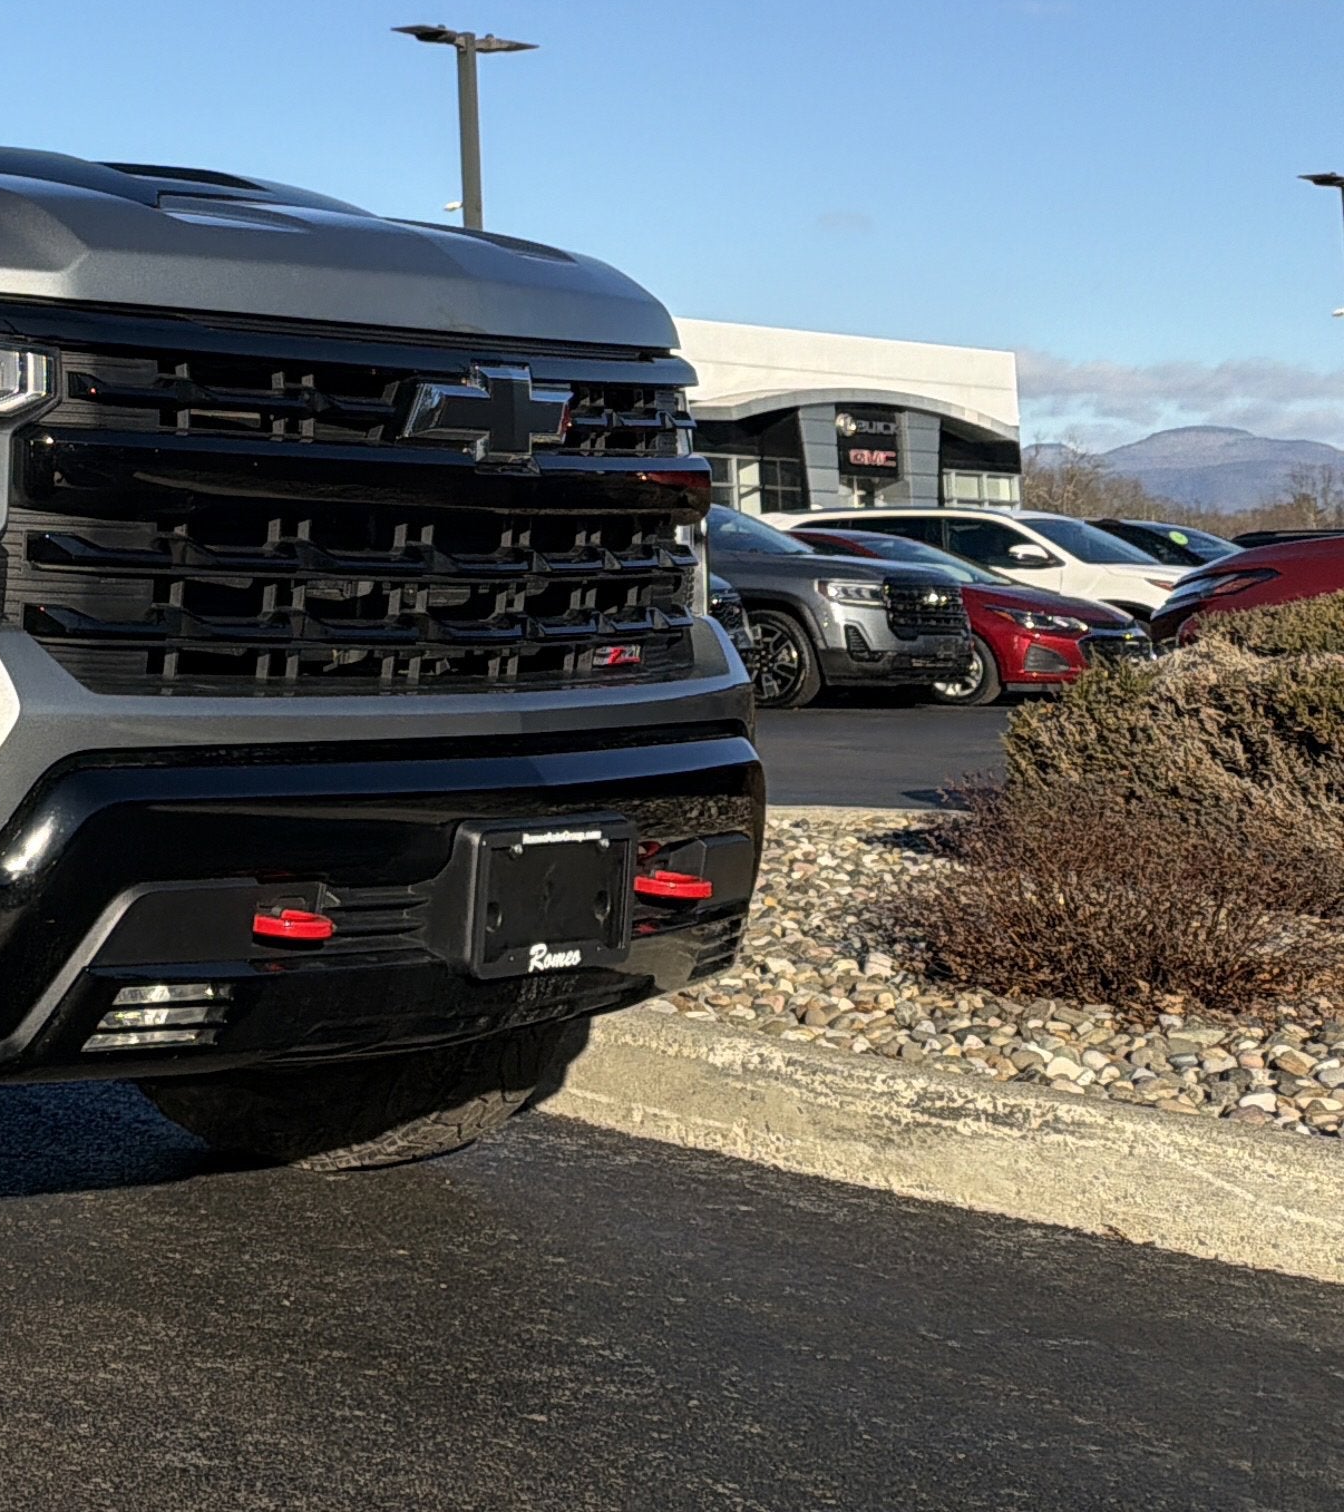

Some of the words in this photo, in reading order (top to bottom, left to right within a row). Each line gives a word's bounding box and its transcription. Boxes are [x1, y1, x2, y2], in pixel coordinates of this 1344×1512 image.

[849, 448, 897, 467] GMC
[593, 644, 641, 664] Z71
[528, 943, 582, 973] Romeo
